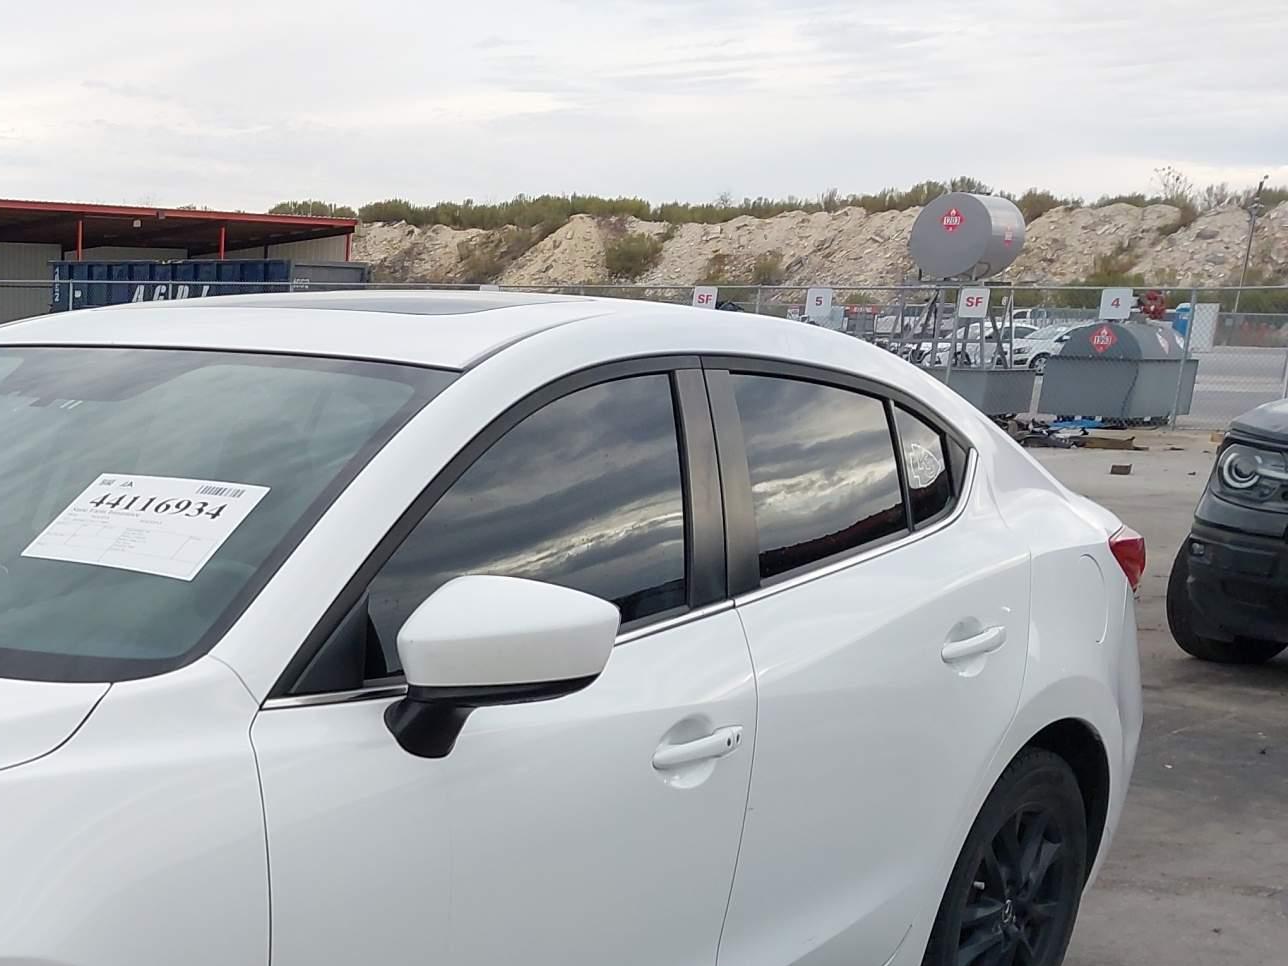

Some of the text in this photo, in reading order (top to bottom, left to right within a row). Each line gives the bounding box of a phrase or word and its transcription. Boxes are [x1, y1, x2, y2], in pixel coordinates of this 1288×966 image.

[697, 294, 712, 304] SF
[815, 297, 823, 306] 5
[966, 297, 983, 307] SF
[1112, 298, 1121, 307] 4
[89, 493, 228, 520] 44116934
